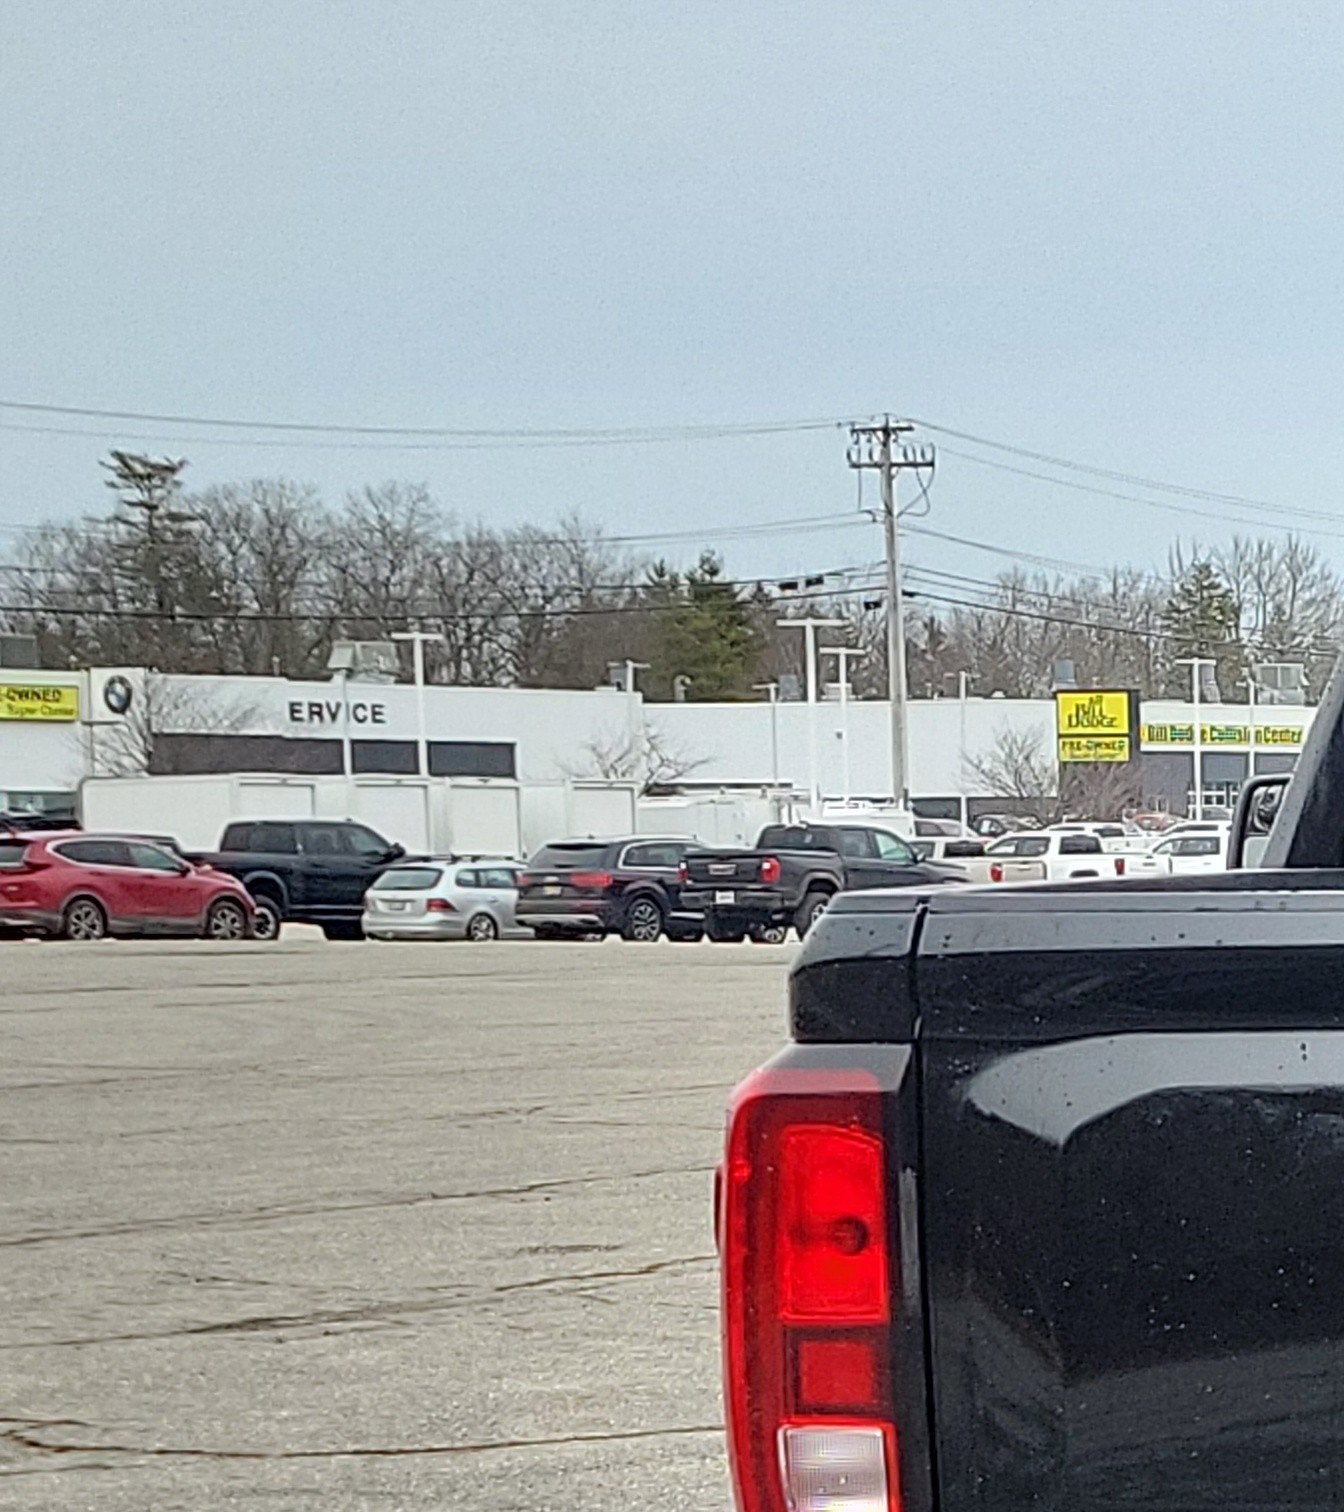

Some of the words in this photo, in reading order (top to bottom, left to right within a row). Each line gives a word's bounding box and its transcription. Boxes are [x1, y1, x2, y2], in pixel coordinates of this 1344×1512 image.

[288, 701, 386, 724] ERVICE
[1170, 724, 1208, 742] Dode
[1210, 725, 1262, 743] Collisin
